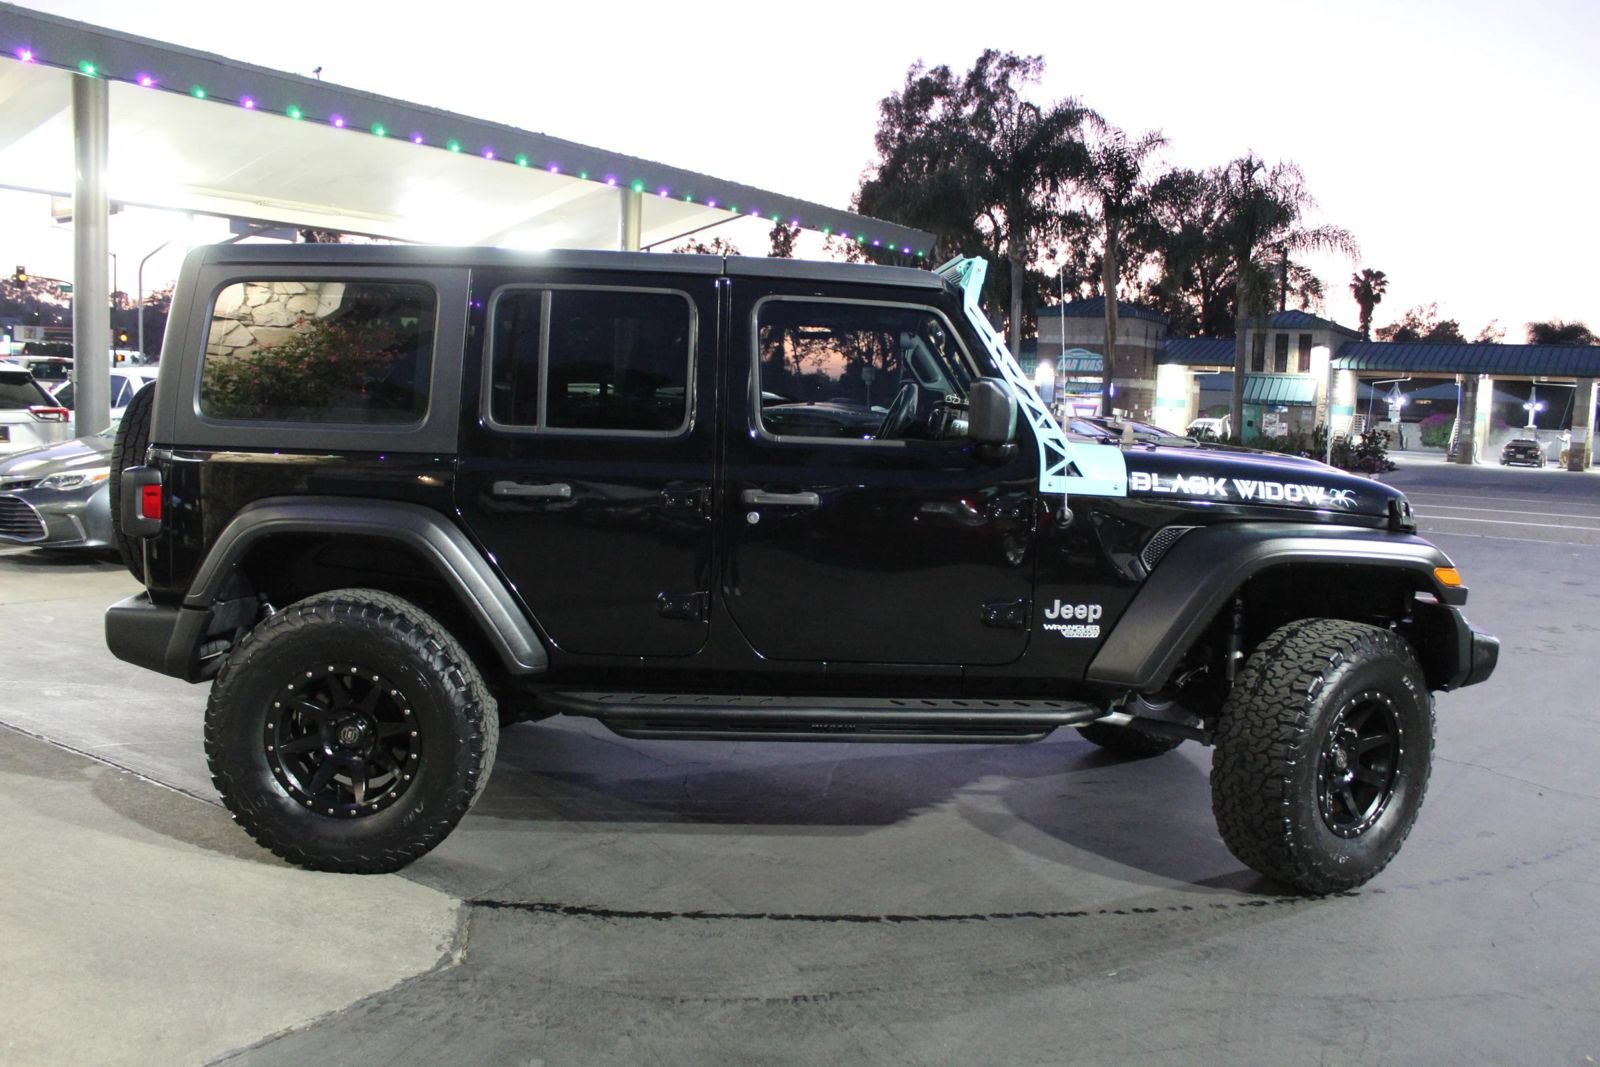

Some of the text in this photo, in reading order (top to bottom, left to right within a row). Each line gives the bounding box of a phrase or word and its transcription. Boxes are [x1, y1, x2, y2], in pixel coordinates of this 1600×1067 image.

[1056, 359, 1078, 371] CAR
[1131, 471, 1326, 505] BLACK WIDOW
[1044, 599, 1102, 623] Jeep
[1043, 623, 1100, 631] WRANGLER
